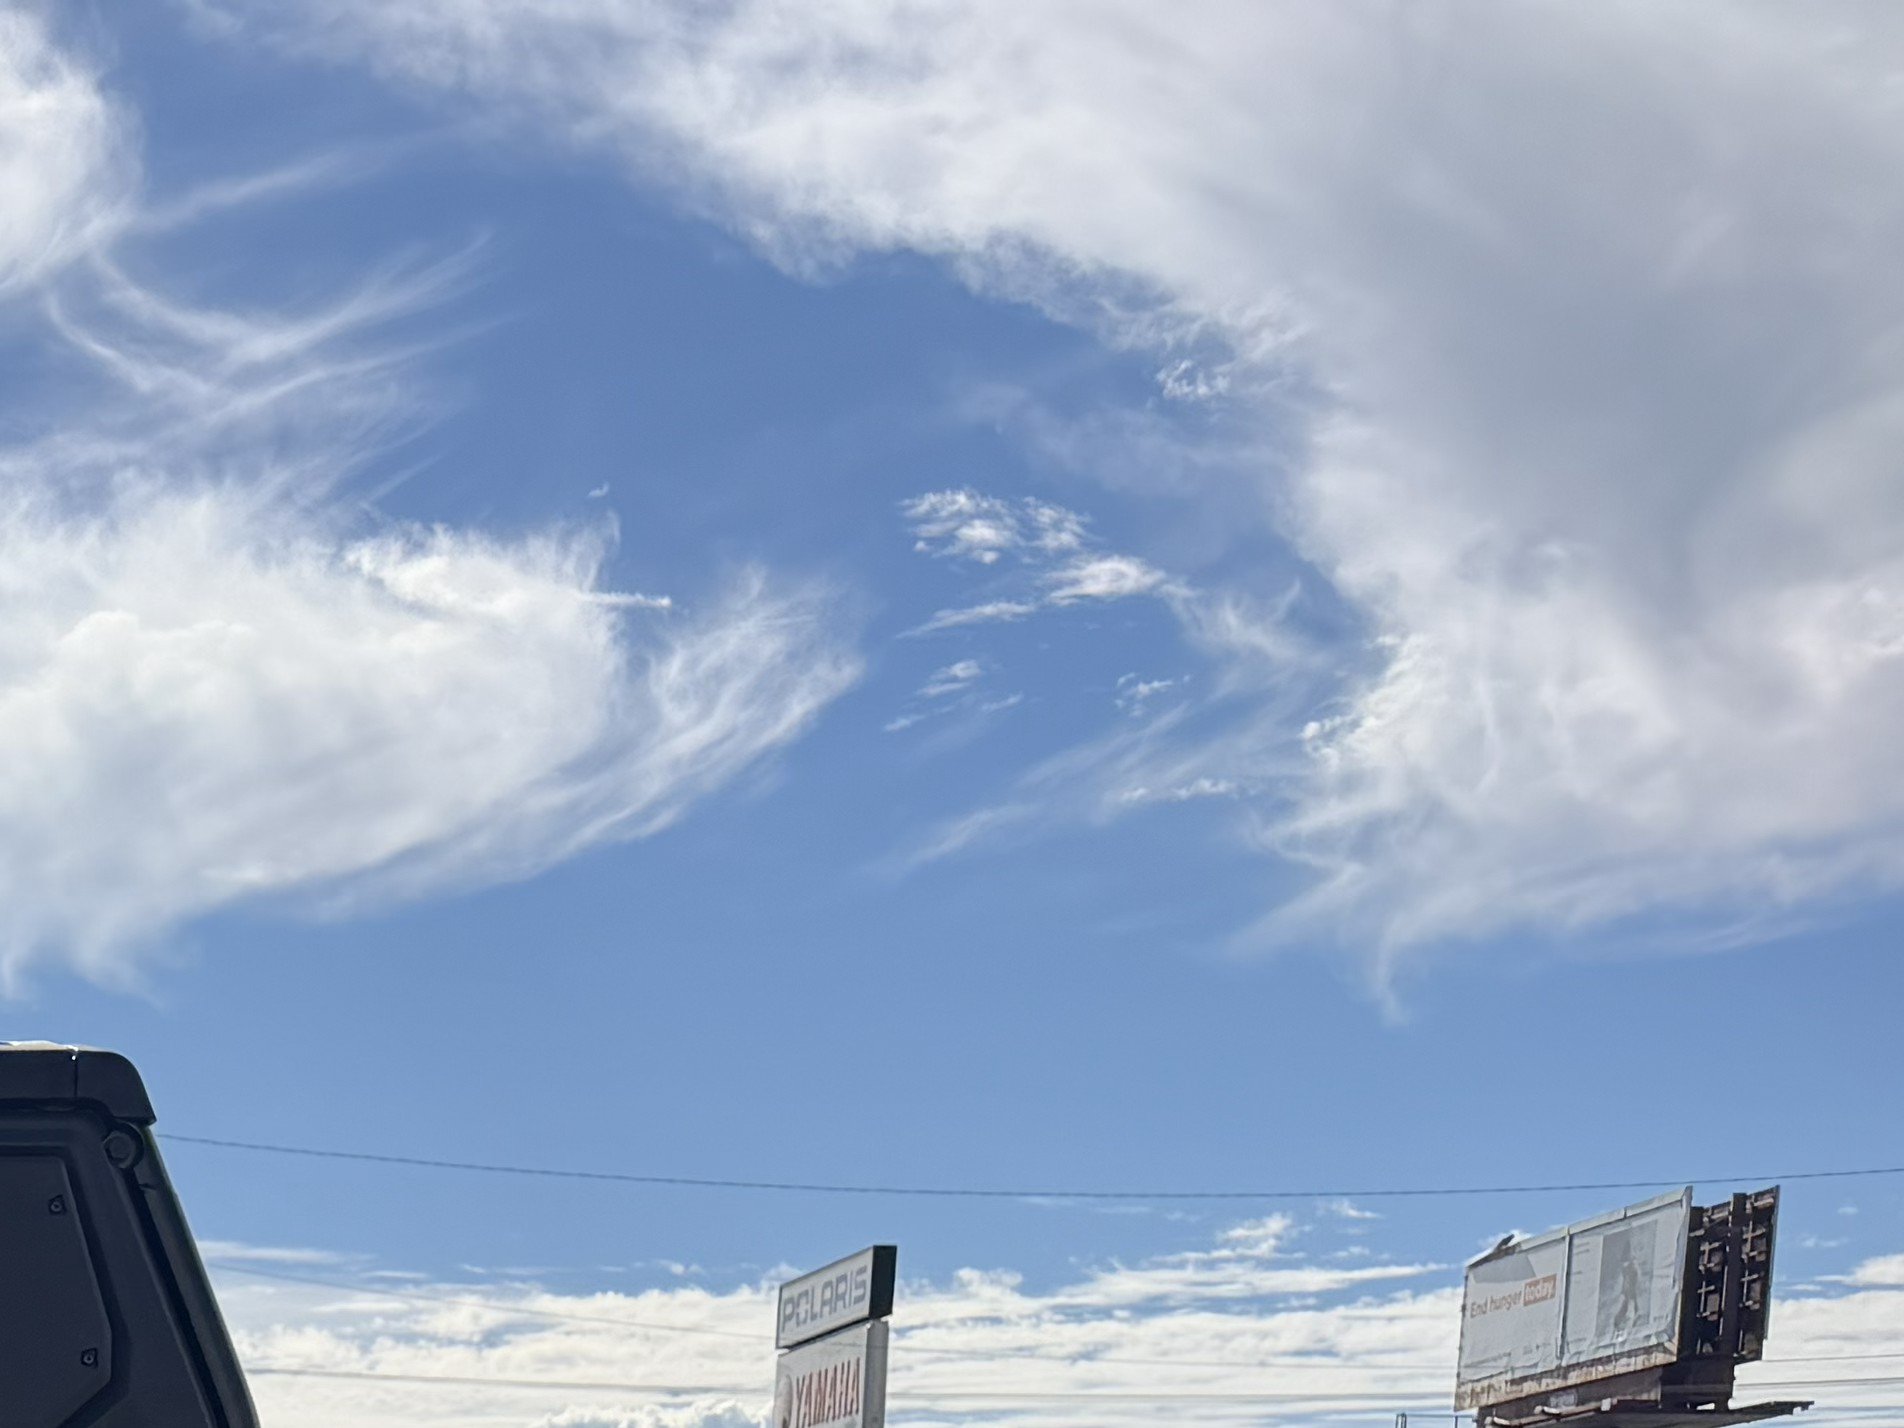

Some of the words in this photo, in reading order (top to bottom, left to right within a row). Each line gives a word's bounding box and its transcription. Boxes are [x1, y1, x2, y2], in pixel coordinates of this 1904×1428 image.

[781, 1265, 867, 1333] POLARIS
[1470, 1297, 1488, 1318] End
[1489, 1290, 1522, 1312] hunger
